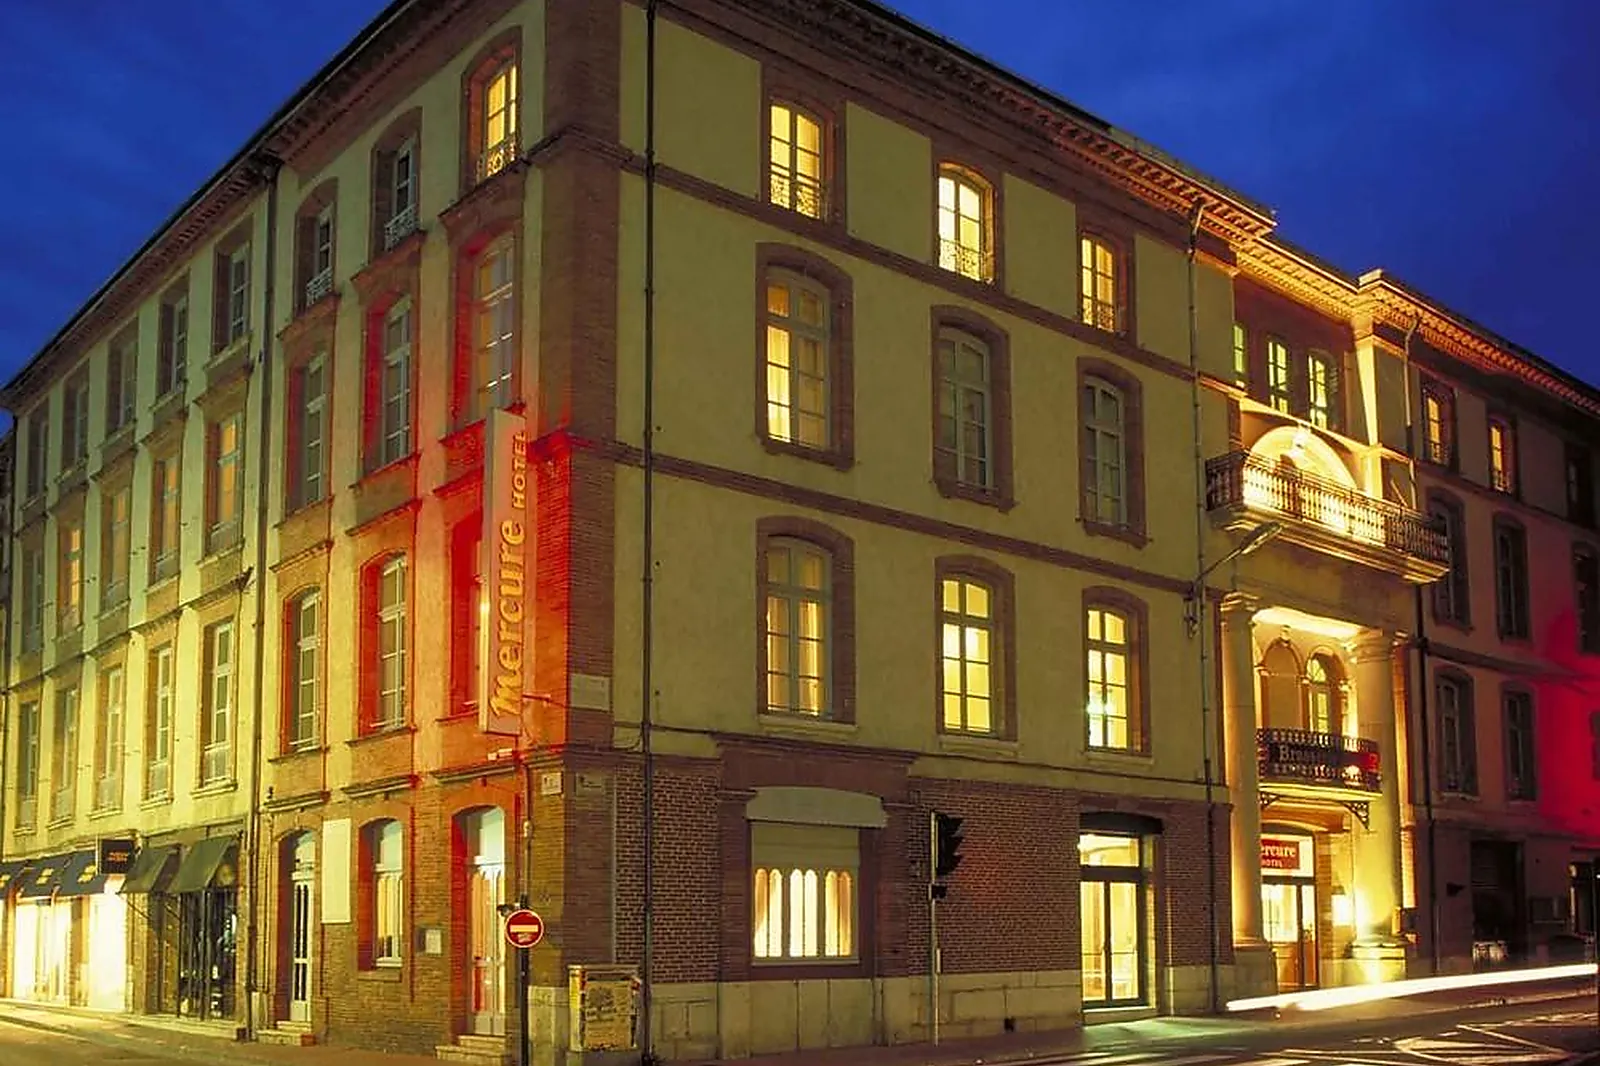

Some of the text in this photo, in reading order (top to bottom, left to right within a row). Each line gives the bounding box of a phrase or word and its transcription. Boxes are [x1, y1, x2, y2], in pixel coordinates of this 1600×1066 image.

[490, 432, 527, 718] Mercure HOTEL
[1260, 845, 1297, 858] ercure
